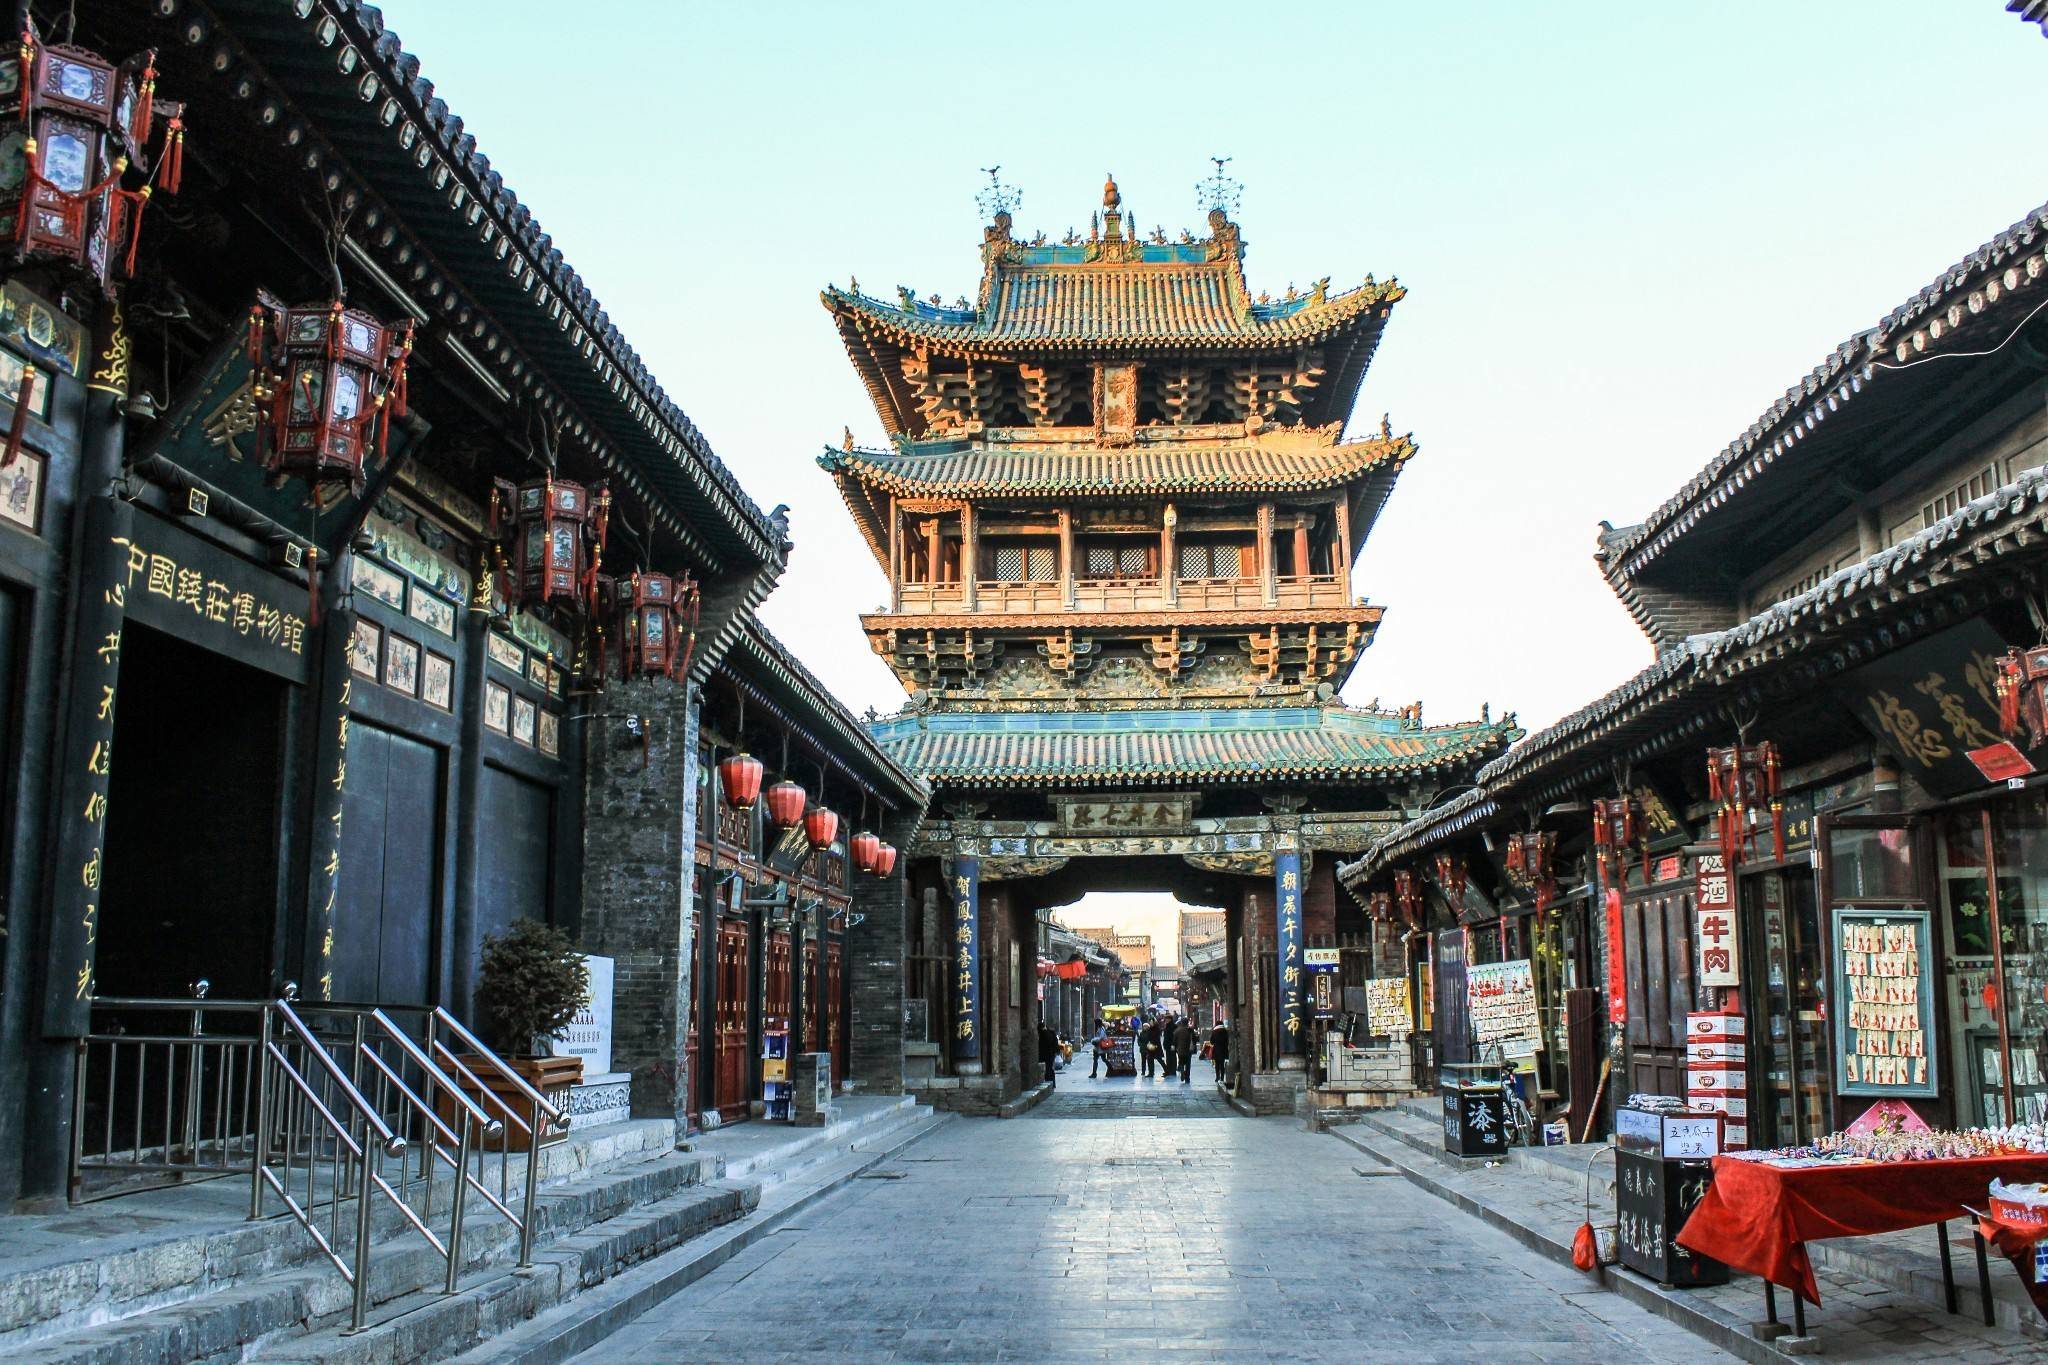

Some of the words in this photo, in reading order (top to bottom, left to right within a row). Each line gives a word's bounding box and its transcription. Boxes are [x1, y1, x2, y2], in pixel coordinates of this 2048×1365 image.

[127, 543, 306, 655] 中國錢莊博物館
[1280, 870, 1301, 1036] 朝晨午夕街三市
[1703, 916, 1730, 974] 牛肉
[1468, 1101, 1497, 1131] 漆
[1619, 1209, 1664, 1259] 推光漆器
